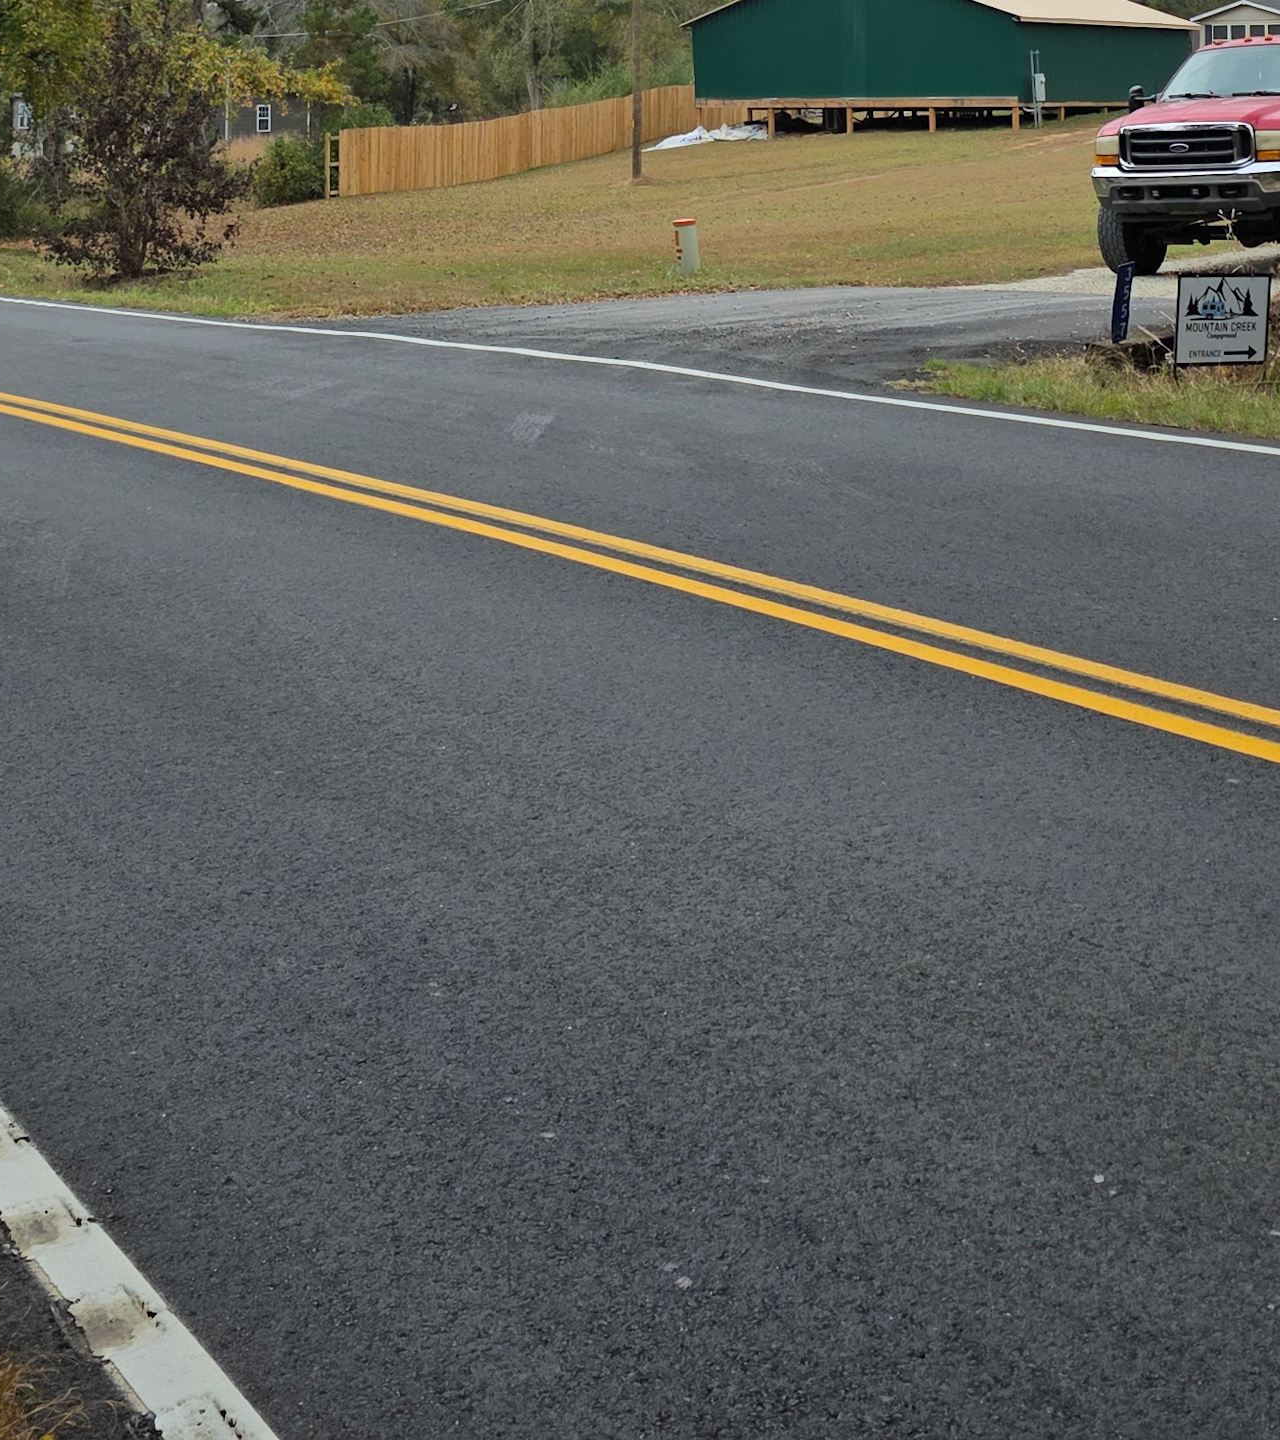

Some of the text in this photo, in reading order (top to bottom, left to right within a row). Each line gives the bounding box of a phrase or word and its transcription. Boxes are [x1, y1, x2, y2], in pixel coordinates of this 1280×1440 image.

[1120, 266, 1132, 337] 3557
[1185, 321, 1257, 333] MOUNTAIN CREEK
[1188, 350, 1221, 359] ENTRANCE
